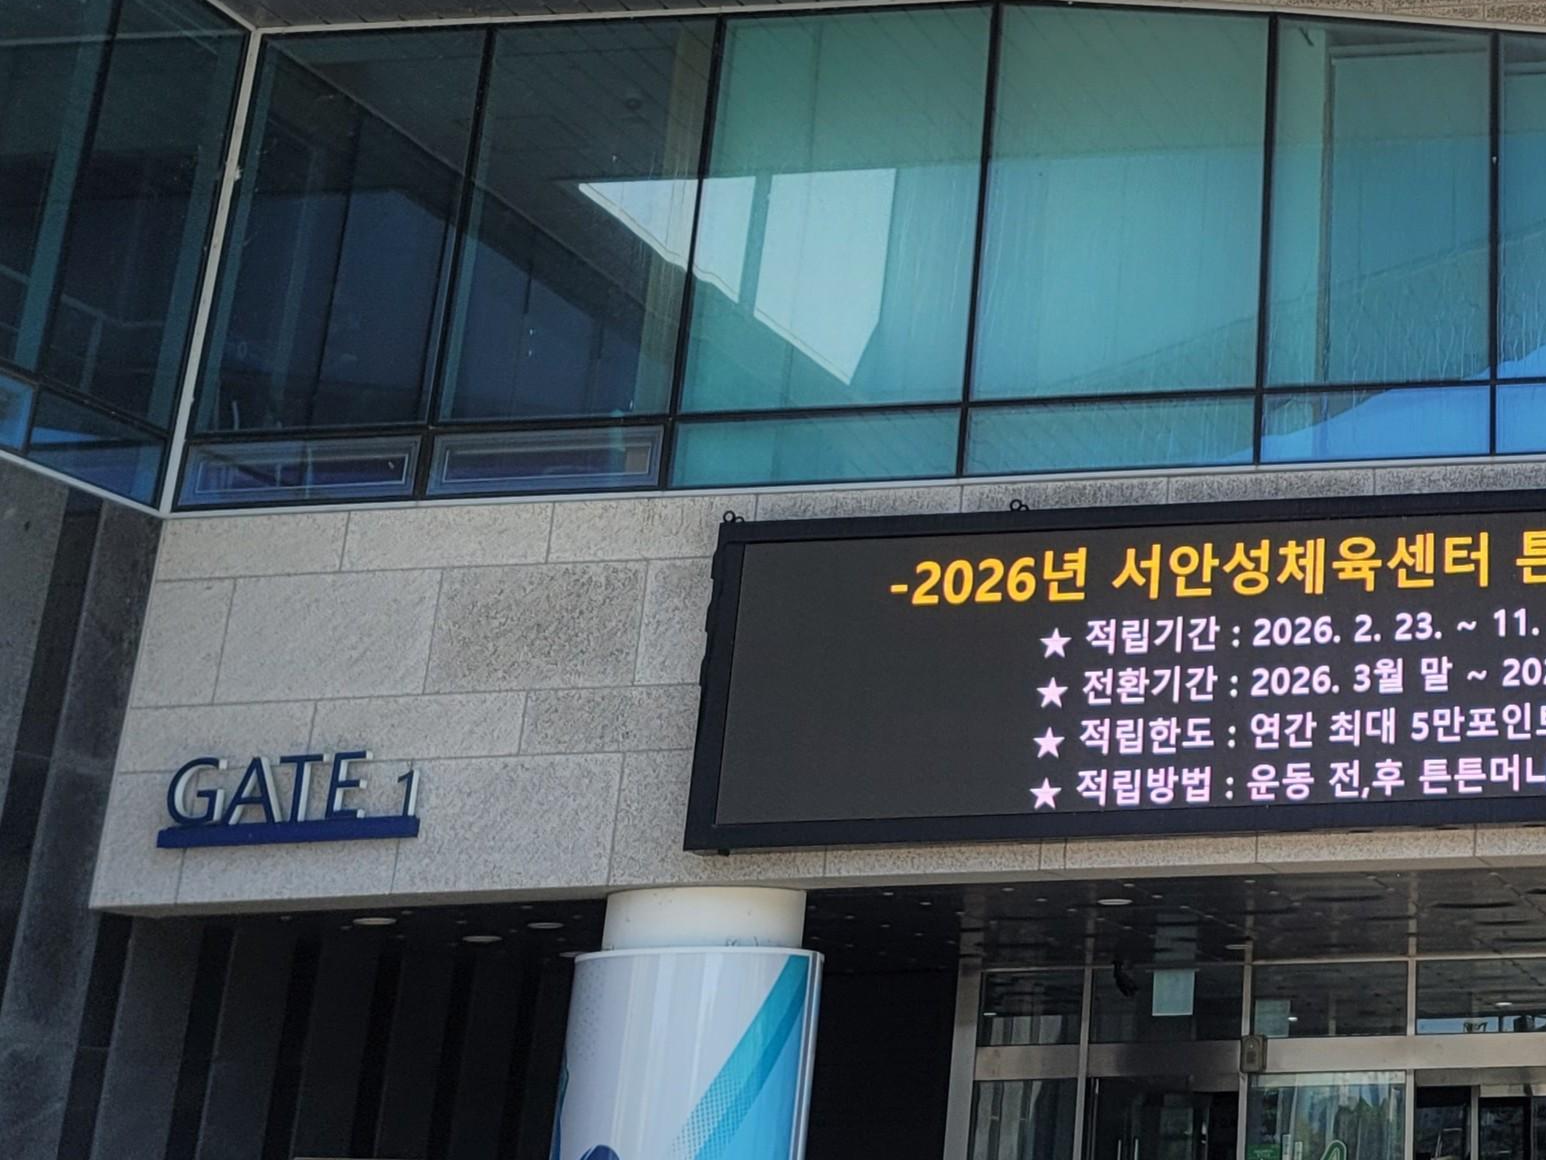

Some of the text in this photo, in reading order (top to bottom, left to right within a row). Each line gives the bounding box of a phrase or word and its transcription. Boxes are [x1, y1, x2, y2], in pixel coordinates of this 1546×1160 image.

[891, 547, 1087, 605] -2026년
[1112, 532, 1488, 599] 서안성체육센터
[1086, 616, 1220, 655] 적립기간
[1253, 616, 1341, 647] 2026.
[1354, 614, 1382, 643] 2.
[1395, 612, 1443, 642] 23.
[1494, 608, 1540, 638] 11.
[1083, 665, 1218, 706] 전환기간
[1251, 665, 1340, 697] 2026.
[1353, 658, 1404, 695] 3월
[1421, 656, 1454, 693] 말
[1080, 717, 1215, 756] 적립한도
[1251, 712, 1318, 750] 연간
[1329, 707, 1396, 747] 최대
[166, 751, 420, 826] GATE 1
[1076, 766, 1212, 807] 적립방법
[1247, 763, 1315, 802] 운동
[1329, 759, 1405, 800] 전,후
